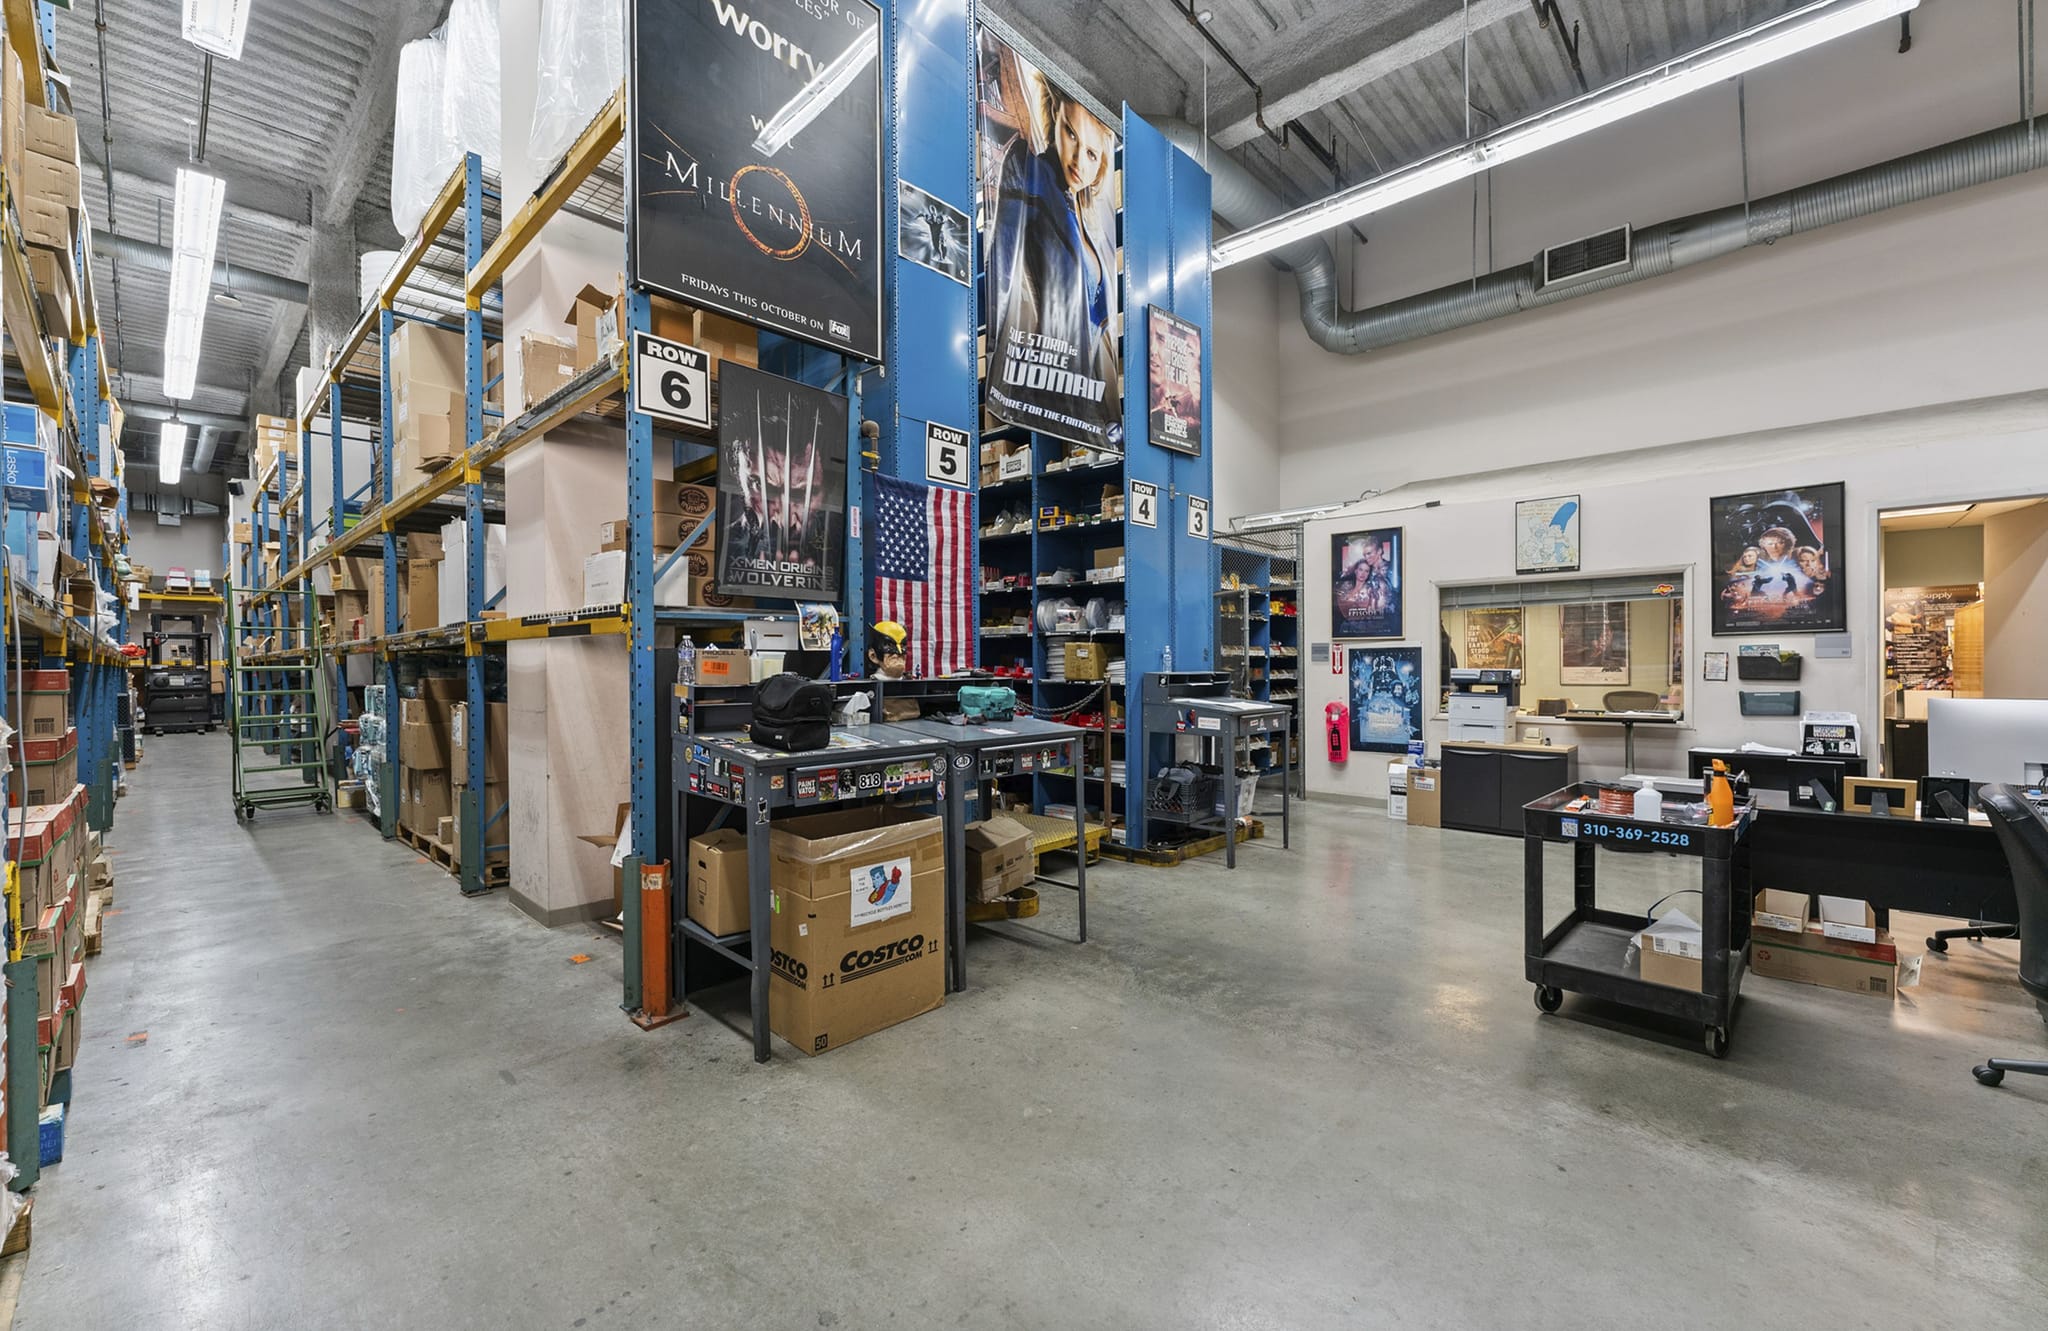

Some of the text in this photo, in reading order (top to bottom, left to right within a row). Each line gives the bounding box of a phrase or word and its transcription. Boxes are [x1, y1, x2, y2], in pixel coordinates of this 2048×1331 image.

[846, 10, 865, 30] OF
[681, 273, 729, 298] FRIDAYS
[732, 290, 758, 308] THIS
[760, 301, 807, 325] OCTOBER
[809, 318, 824, 331] ON
[647, 341, 697, 367] ROW
[1027, 333, 1067, 354] STORM
[1006, 342, 1070, 369] INVISIBLE
[660, 370, 692, 410] 6
[1003, 358, 1106, 402] WOMAN
[1023, 401, 1042, 416] FOR
[1043, 408, 1061, 422] THE
[932, 427, 963, 445] ROW
[6, 449, 19, 484] Lasko
[939, 447, 957, 476] 5
[1134, 483, 1153, 495] ROW
[1138, 499, 1150, 520] 4
[1191, 498, 1206, 509] ROW
[1194, 511, 1203, 533] 3
[729, 556, 834, 576] X-MEN ORIGINS
[729, 570, 834, 590] WOLVERINE
[1348, 609, 1377, 617] EPISODE
[798, 780, 816, 789] PAINT
[859, 773, 881, 789] 818
[1583, 822, 1690, 847] 310-369-2528
[840, 934, 925, 973] COSTCO
[815, 1035, 828, 1050] 50
